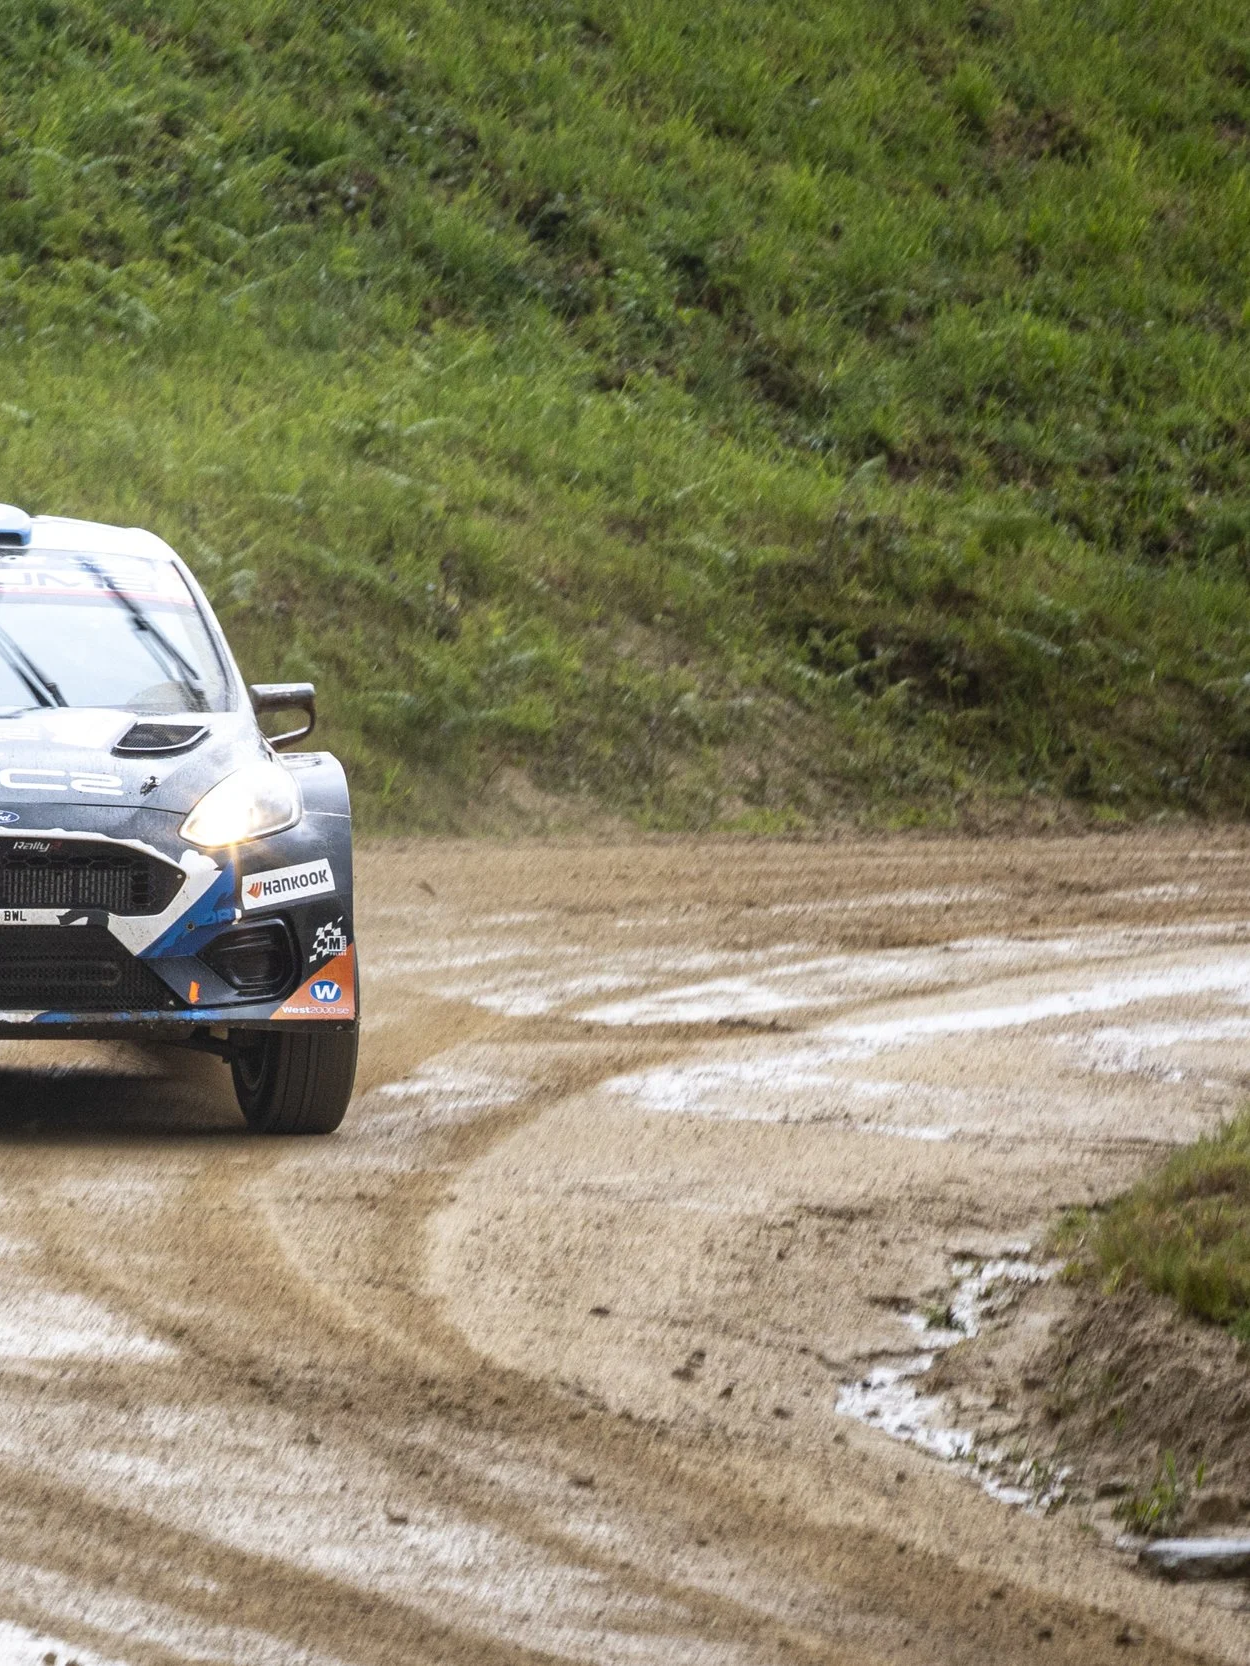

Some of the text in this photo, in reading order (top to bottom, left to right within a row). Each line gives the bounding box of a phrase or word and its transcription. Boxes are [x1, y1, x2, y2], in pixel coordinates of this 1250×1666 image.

[262, 869, 330, 896] Hankook
[4, 909, 27, 922] BWL
[329, 937, 341, 950] M
[313, 983, 340, 1000] W
